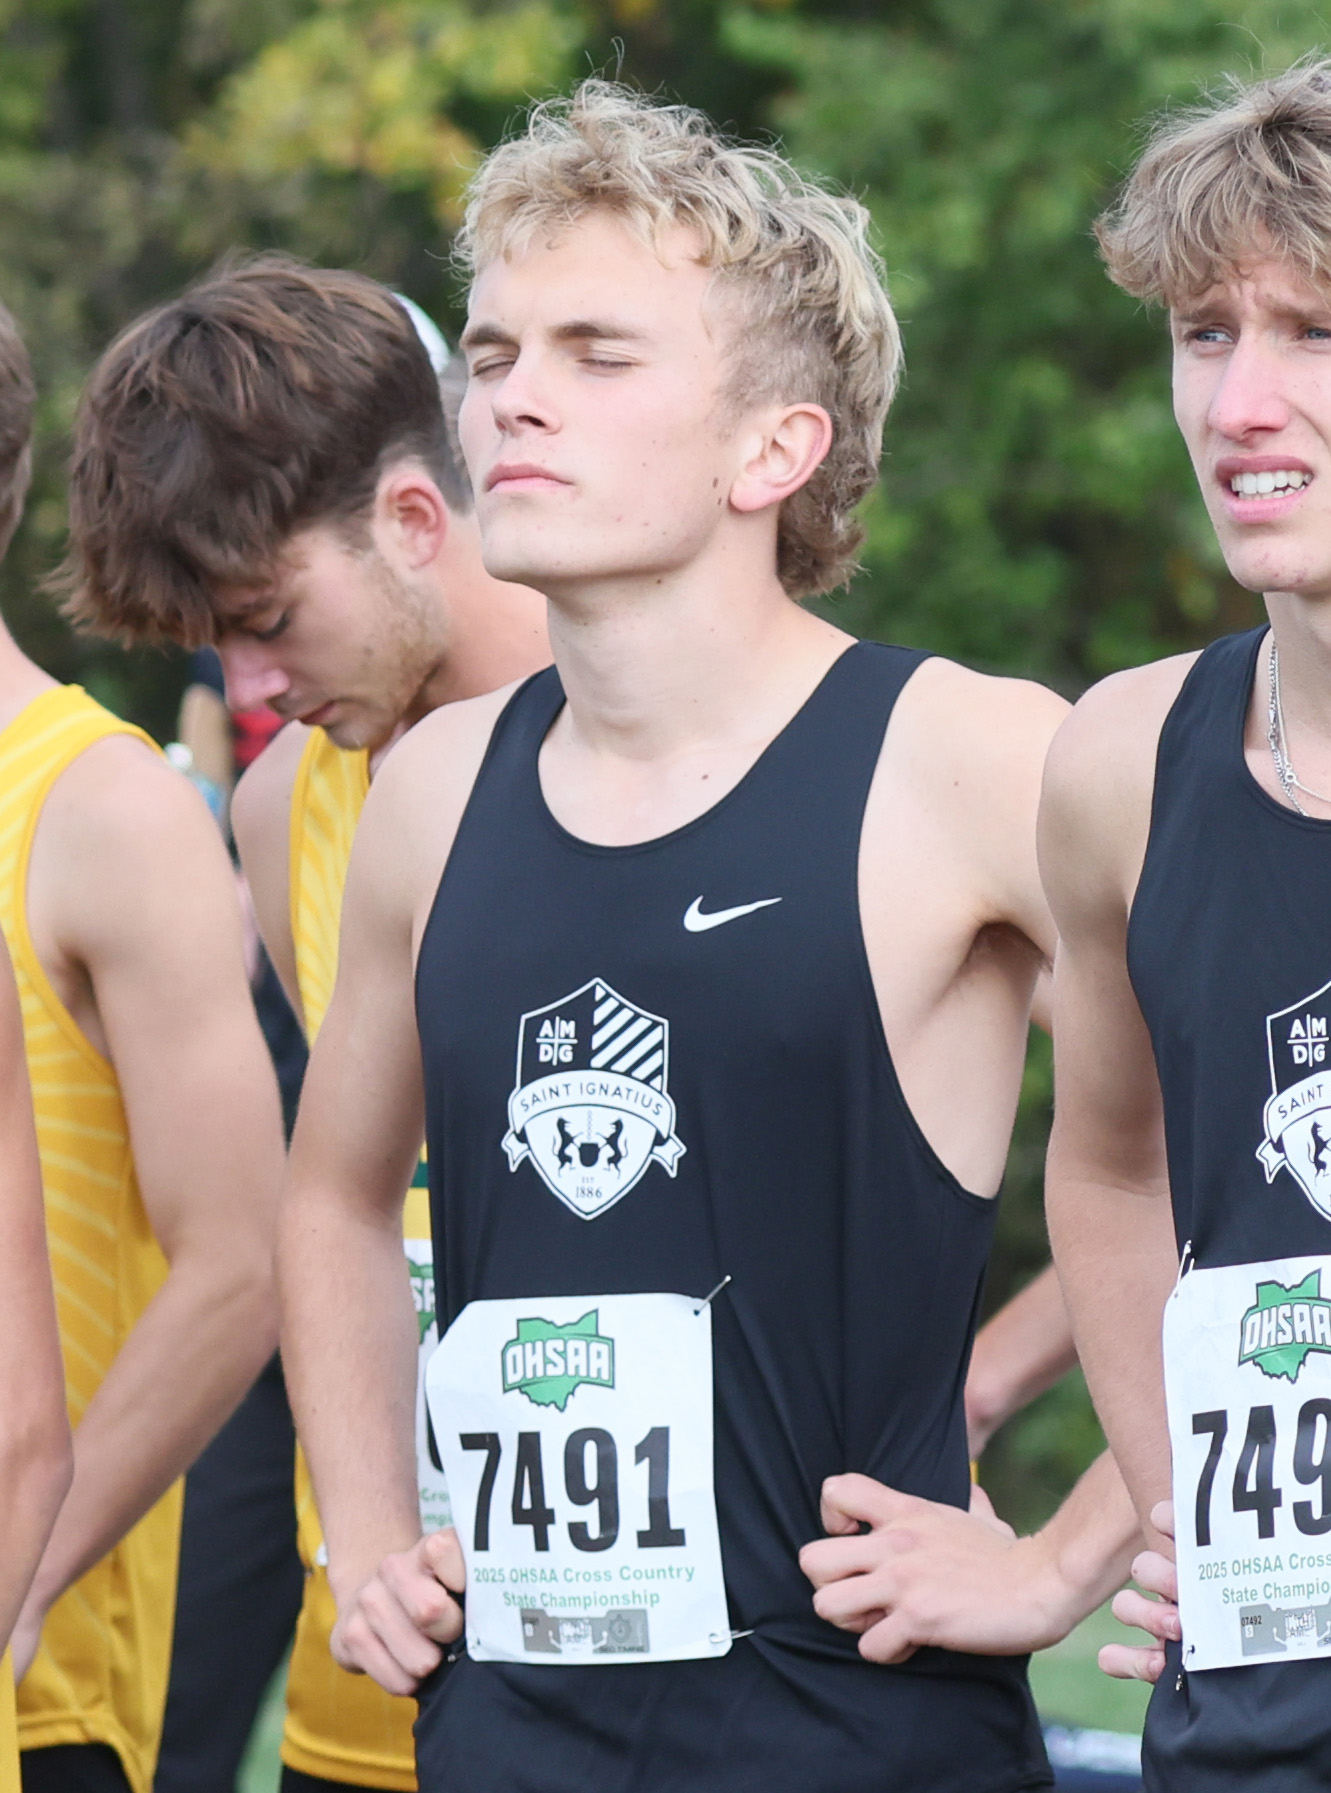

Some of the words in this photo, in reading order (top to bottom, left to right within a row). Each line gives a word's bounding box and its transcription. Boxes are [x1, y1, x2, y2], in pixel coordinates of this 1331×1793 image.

[520, 1083, 572, 1112] SAINT
[579, 1082, 664, 1116] IGNATIUS
[1277, 1084, 1324, 1119] SAINT
[575, 1186, 603, 1199] 1886
[505, 1338, 612, 1385] OHSAA
[459, 1426, 686, 1552] 7491
[474, 1567, 506, 1583] 2025
[509, 1567, 559, 1584] OHSAA
[563, 1567, 613, 1583] Cross
[619, 1565, 695, 1582] Country
[1198, 1561, 1228, 1580] 2025
[1231, 1555, 1284, 1576] OHSAA
[502, 1591, 537, 1608] State
[540, 1589, 660, 1610] Championship
[1222, 1586, 1259, 1604] State
[1240, 1615, 1262, 1627] 07492
